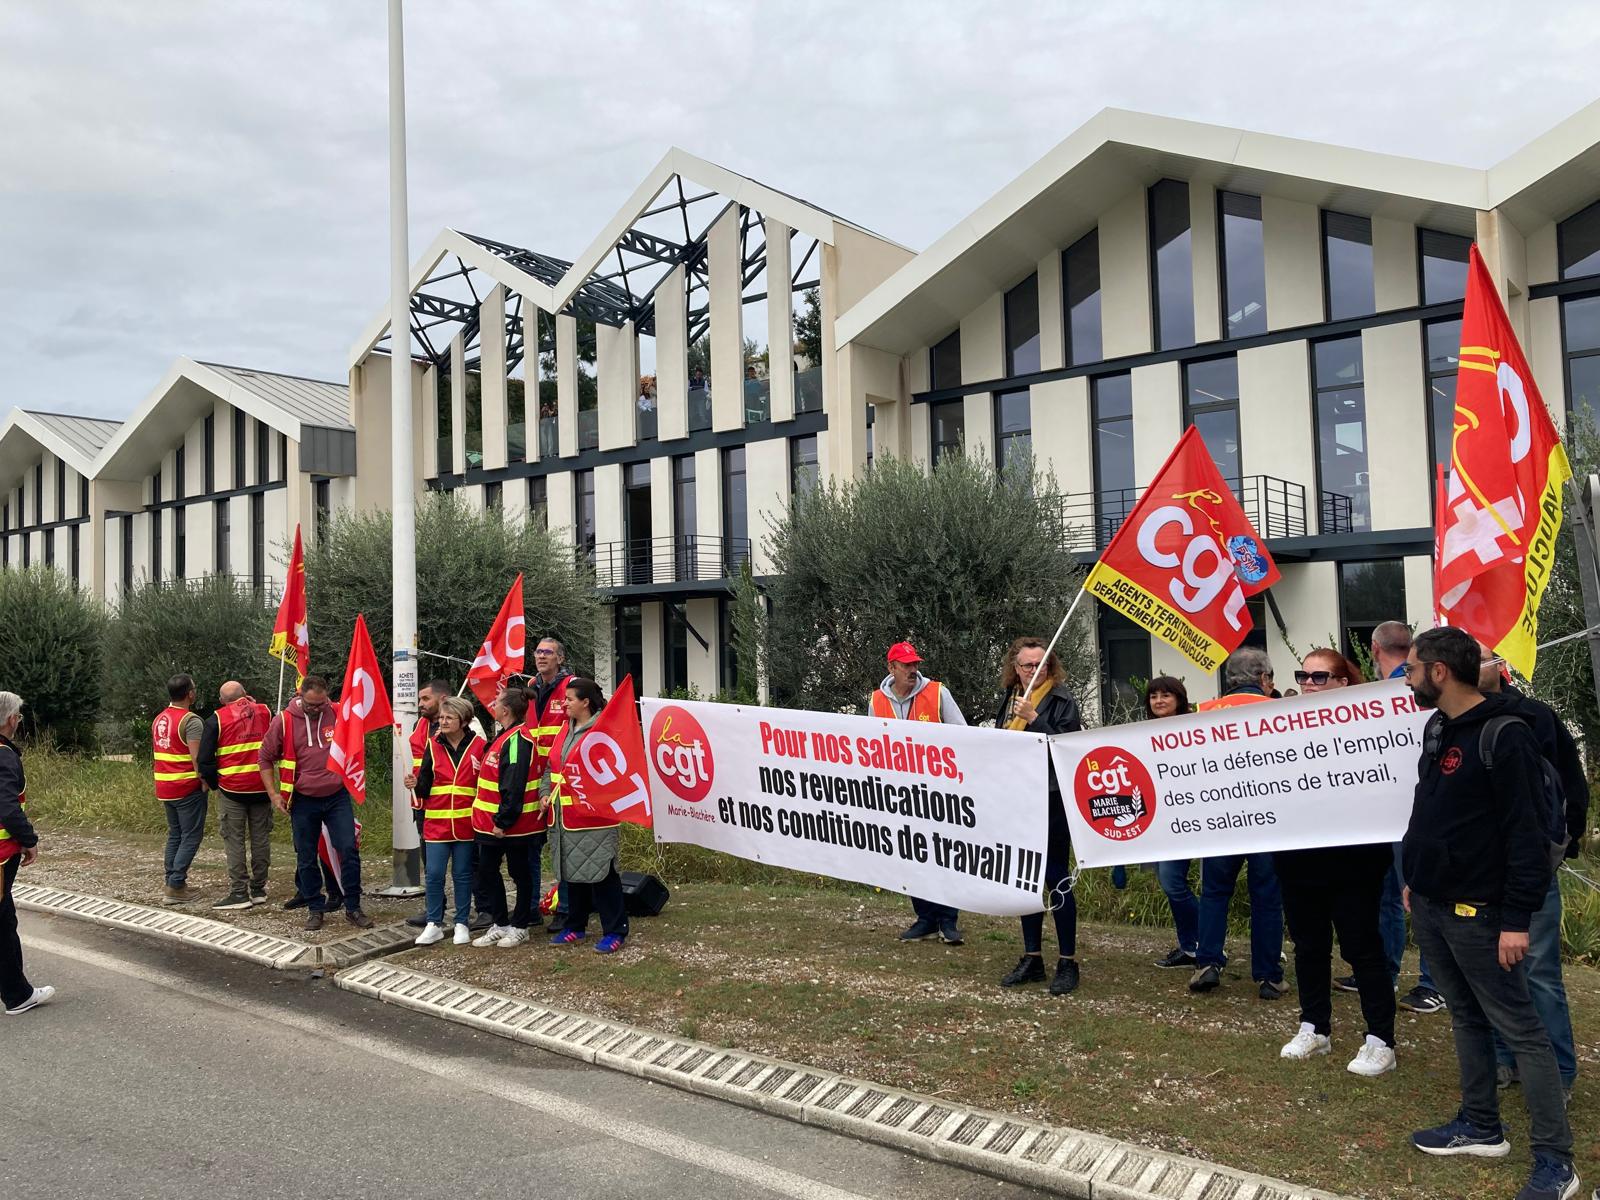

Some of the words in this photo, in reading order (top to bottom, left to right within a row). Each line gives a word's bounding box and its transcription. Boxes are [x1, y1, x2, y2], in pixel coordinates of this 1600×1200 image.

[1237, 545, 1260, 574] FSM
[1093, 581, 1164, 632] DÉPARTEMENT
[1162, 627, 1178, 642] DU
[1178, 637, 1216, 670] VAUCLUSE
[1112, 579, 1154, 610] AGENTS
[1155, 605, 1212, 652] TERRITORIAUX
[657, 715, 691, 746] la
[1150, 729, 1206, 752] NOUS
[1211, 723, 1240, 742] NE
[1245, 700, 1385, 738] LACHERONS
[1391, 694, 1434, 715] RI
[580, 731, 651, 817] GT
[656, 739, 709, 788] cgt
[759, 721, 807, 759] Pour
[811, 732, 853, 765] nos
[856, 734, 964, 784] salaires,
[1086, 757, 1100, 771] la
[1157, 762, 1197, 779] Pour
[1202, 758, 1219, 774] la
[1224, 748, 1298, 770] défense
[1304, 741, 1328, 760] de
[1333, 727, 1422, 755] l'emploi,
[759, 766, 797, 798] nos
[800, 771, 976, 829] revendications
[1087, 764, 1132, 794] cgt
[1164, 790, 1195, 807] des
[1200, 779, 1292, 803] conditions
[1298, 773, 1322, 791] de
[1327, 763, 1398, 787] travail,
[667, 804, 716, 823] Marie-Blachère
[1092, 804, 1132, 817] BLACHÈRE
[1093, 797, 1118, 808] MARIE
[1171, 817, 1202, 834] des
[1206, 810, 1277, 830] salaires
[718, 796, 737, 826] et
[739, 801, 774, 833] nos
[777, 808, 894, 856] conditions
[897, 824, 928, 863] de
[932, 832, 1012, 886] travail
[1015, 847, 1042, 894] !!!
[1104, 824, 1142, 839] SUD-EST
